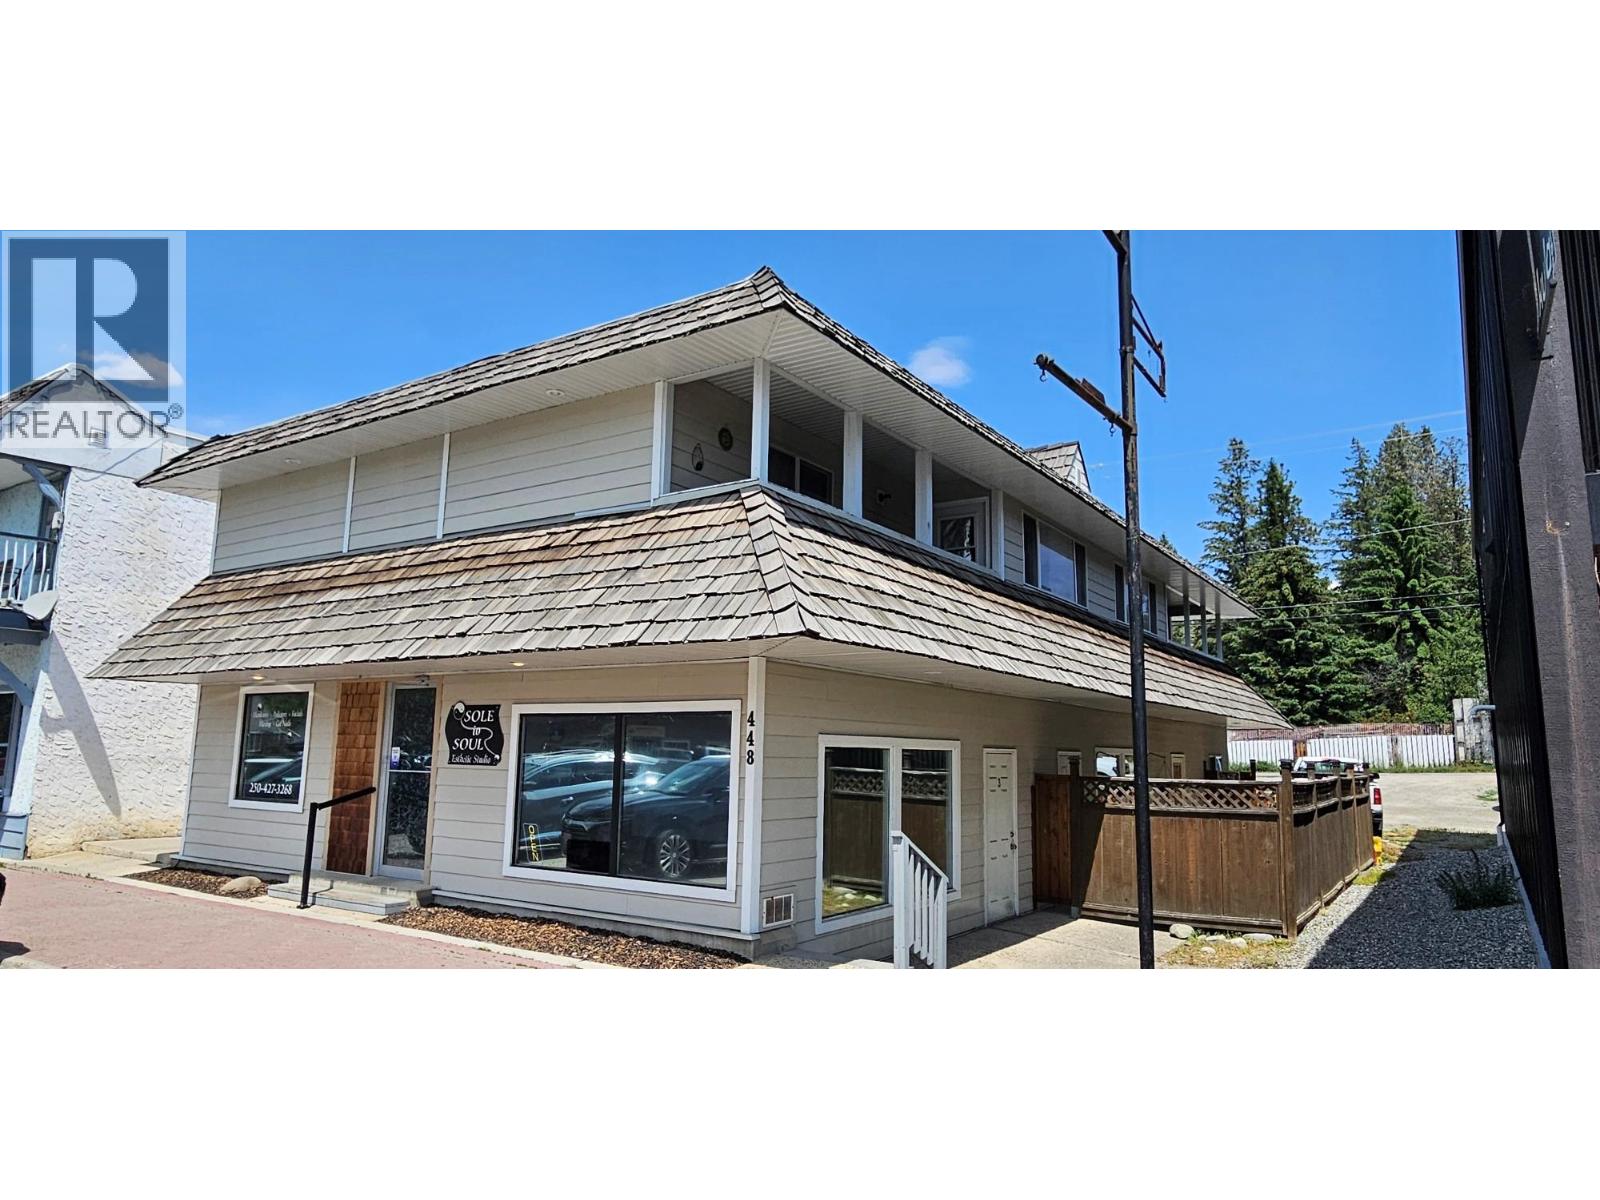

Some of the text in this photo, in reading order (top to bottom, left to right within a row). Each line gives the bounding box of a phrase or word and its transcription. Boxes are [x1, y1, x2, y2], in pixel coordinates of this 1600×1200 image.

[464, 710, 494, 722] SOLE
[472, 725, 481, 736] to
[452, 737, 484, 751] SOUL
[746, 710, 756, 765] 448
[473, 754, 491, 764] Studio
[249, 782, 293, 795] 250-427-3268
[528, 825, 539, 861] OPEN
